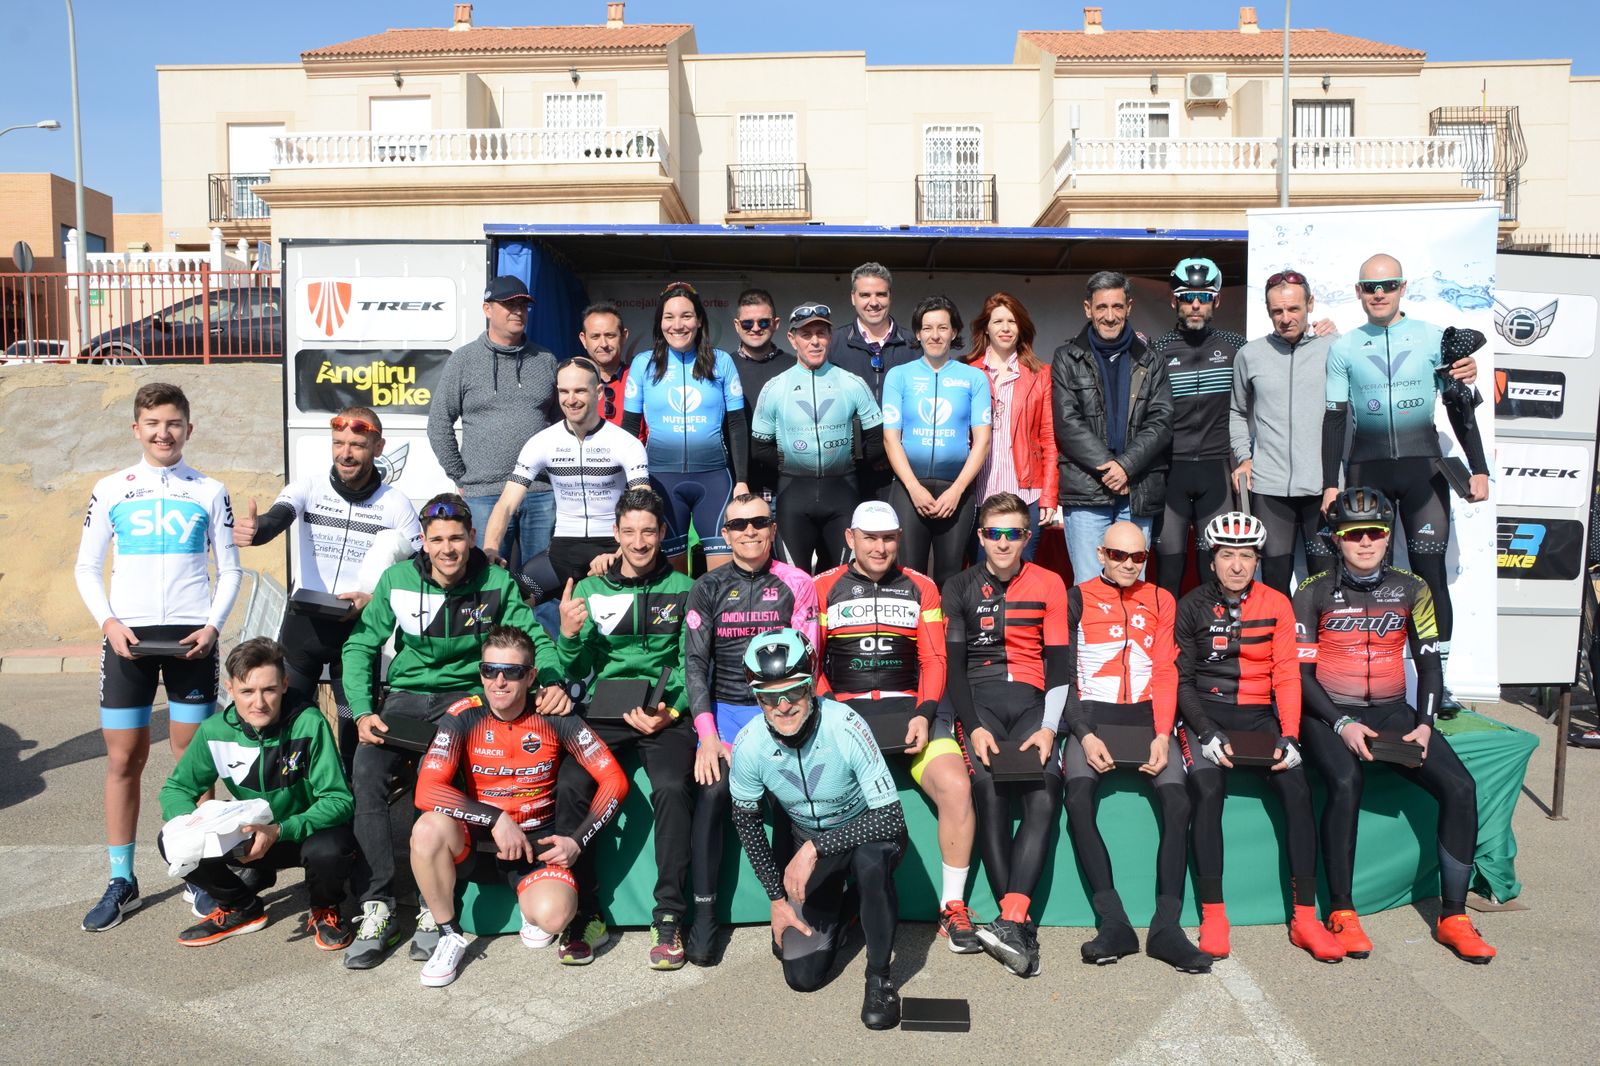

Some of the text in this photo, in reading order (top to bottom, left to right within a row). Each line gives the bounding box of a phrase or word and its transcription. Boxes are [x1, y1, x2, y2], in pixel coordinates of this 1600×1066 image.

[357, 301, 447, 311] TREK
[316, 360, 416, 391] Angliru
[372, 383, 432, 406] bike
[1509, 387, 1561, 397] TREK
[662, 415, 707, 424] NUTRIFER
[912, 427, 956, 438] NUTRIFER
[1502, 466, 1581, 479] TREK
[315, 503, 344, 514] TREK
[129, 501, 199, 544] sky
[762, 587, 779, 598] 35
[976, 605, 991, 614] Km
[721, 612, 745, 623] UNION
[716, 626, 756, 638] MARTINEZ
[1209, 625, 1225, 633] Km
[859, 636, 894, 652] OC
[473, 747, 504, 757] MARCRI
